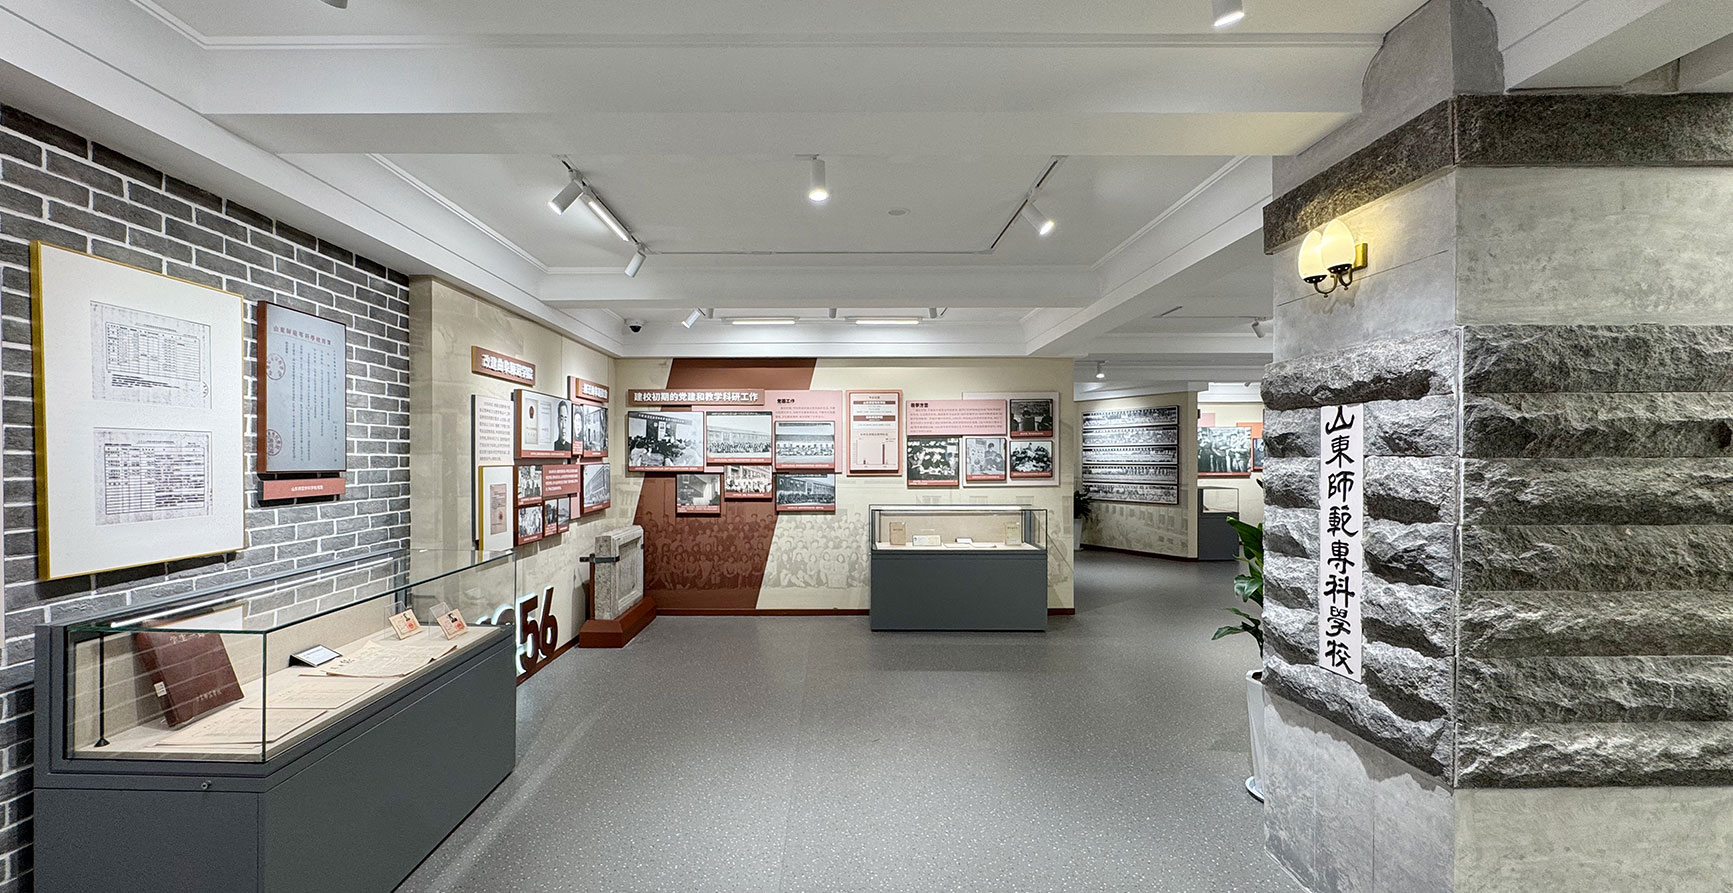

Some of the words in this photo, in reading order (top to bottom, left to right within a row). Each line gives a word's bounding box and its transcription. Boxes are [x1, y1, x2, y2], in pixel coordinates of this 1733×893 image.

[633, 391, 759, 403] 建校初期的党建和教学科研工作
[1323, 405, 1358, 675] 山東師範專科學校
